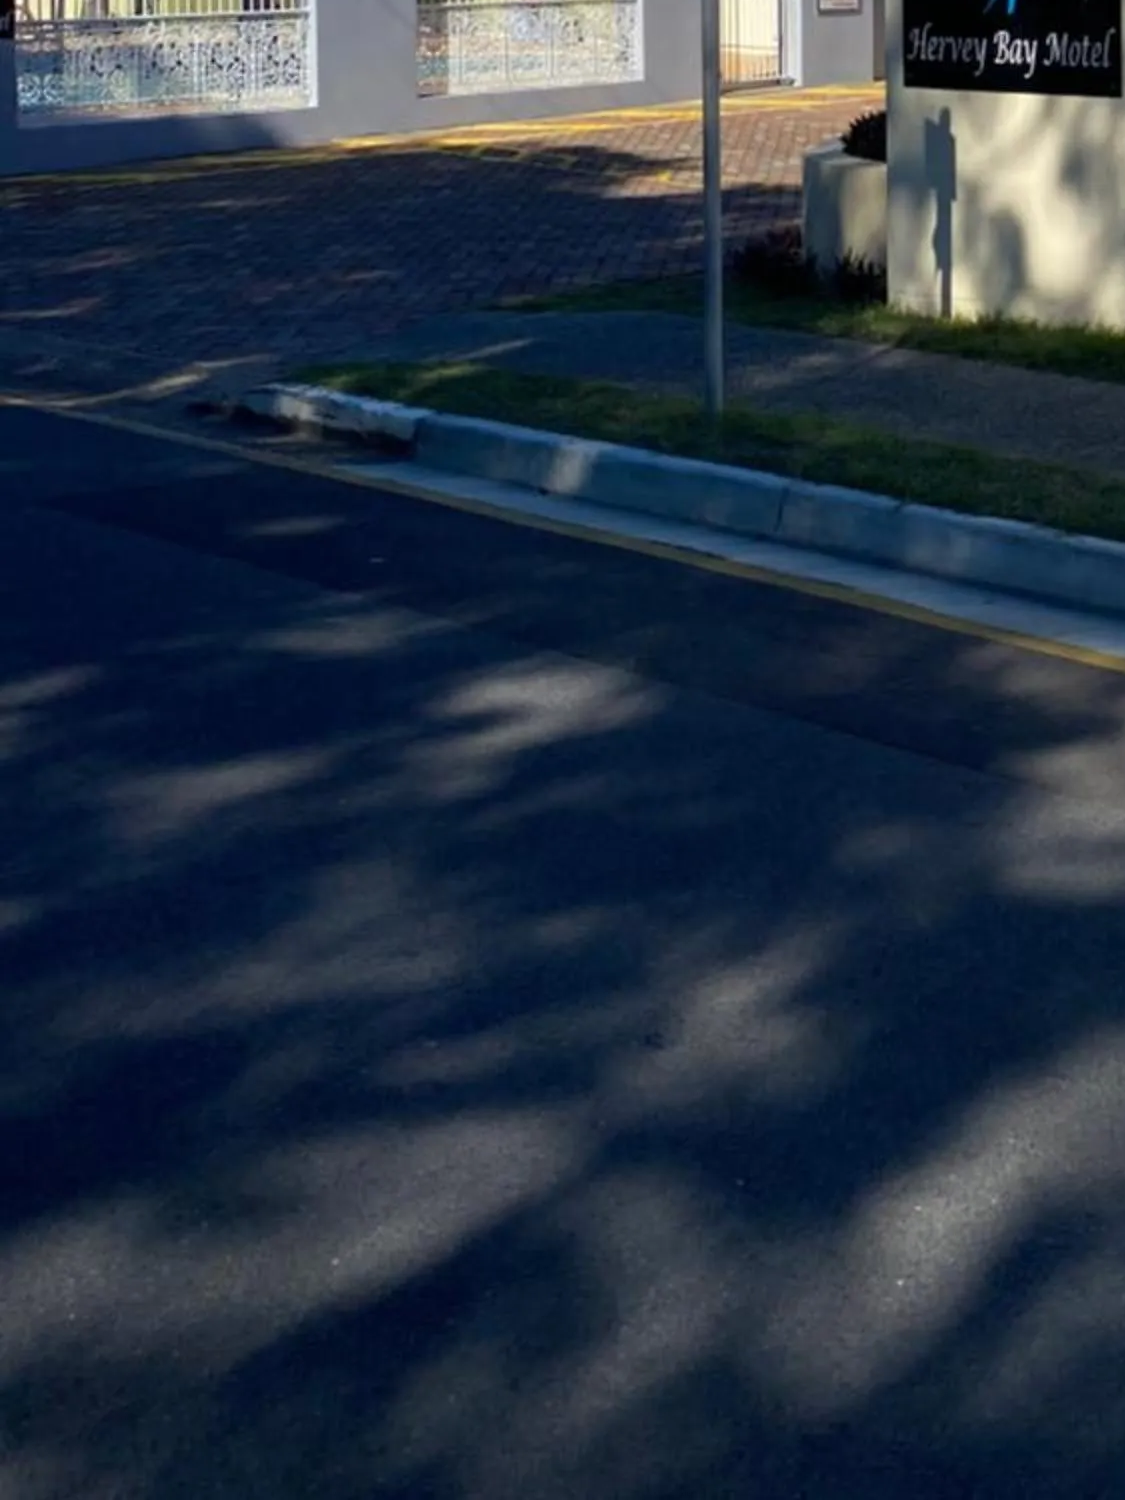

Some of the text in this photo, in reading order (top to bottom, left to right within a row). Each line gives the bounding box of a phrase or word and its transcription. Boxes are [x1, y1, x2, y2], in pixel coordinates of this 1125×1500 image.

[907, 22, 1116, 79] Hervey Bay Motel
